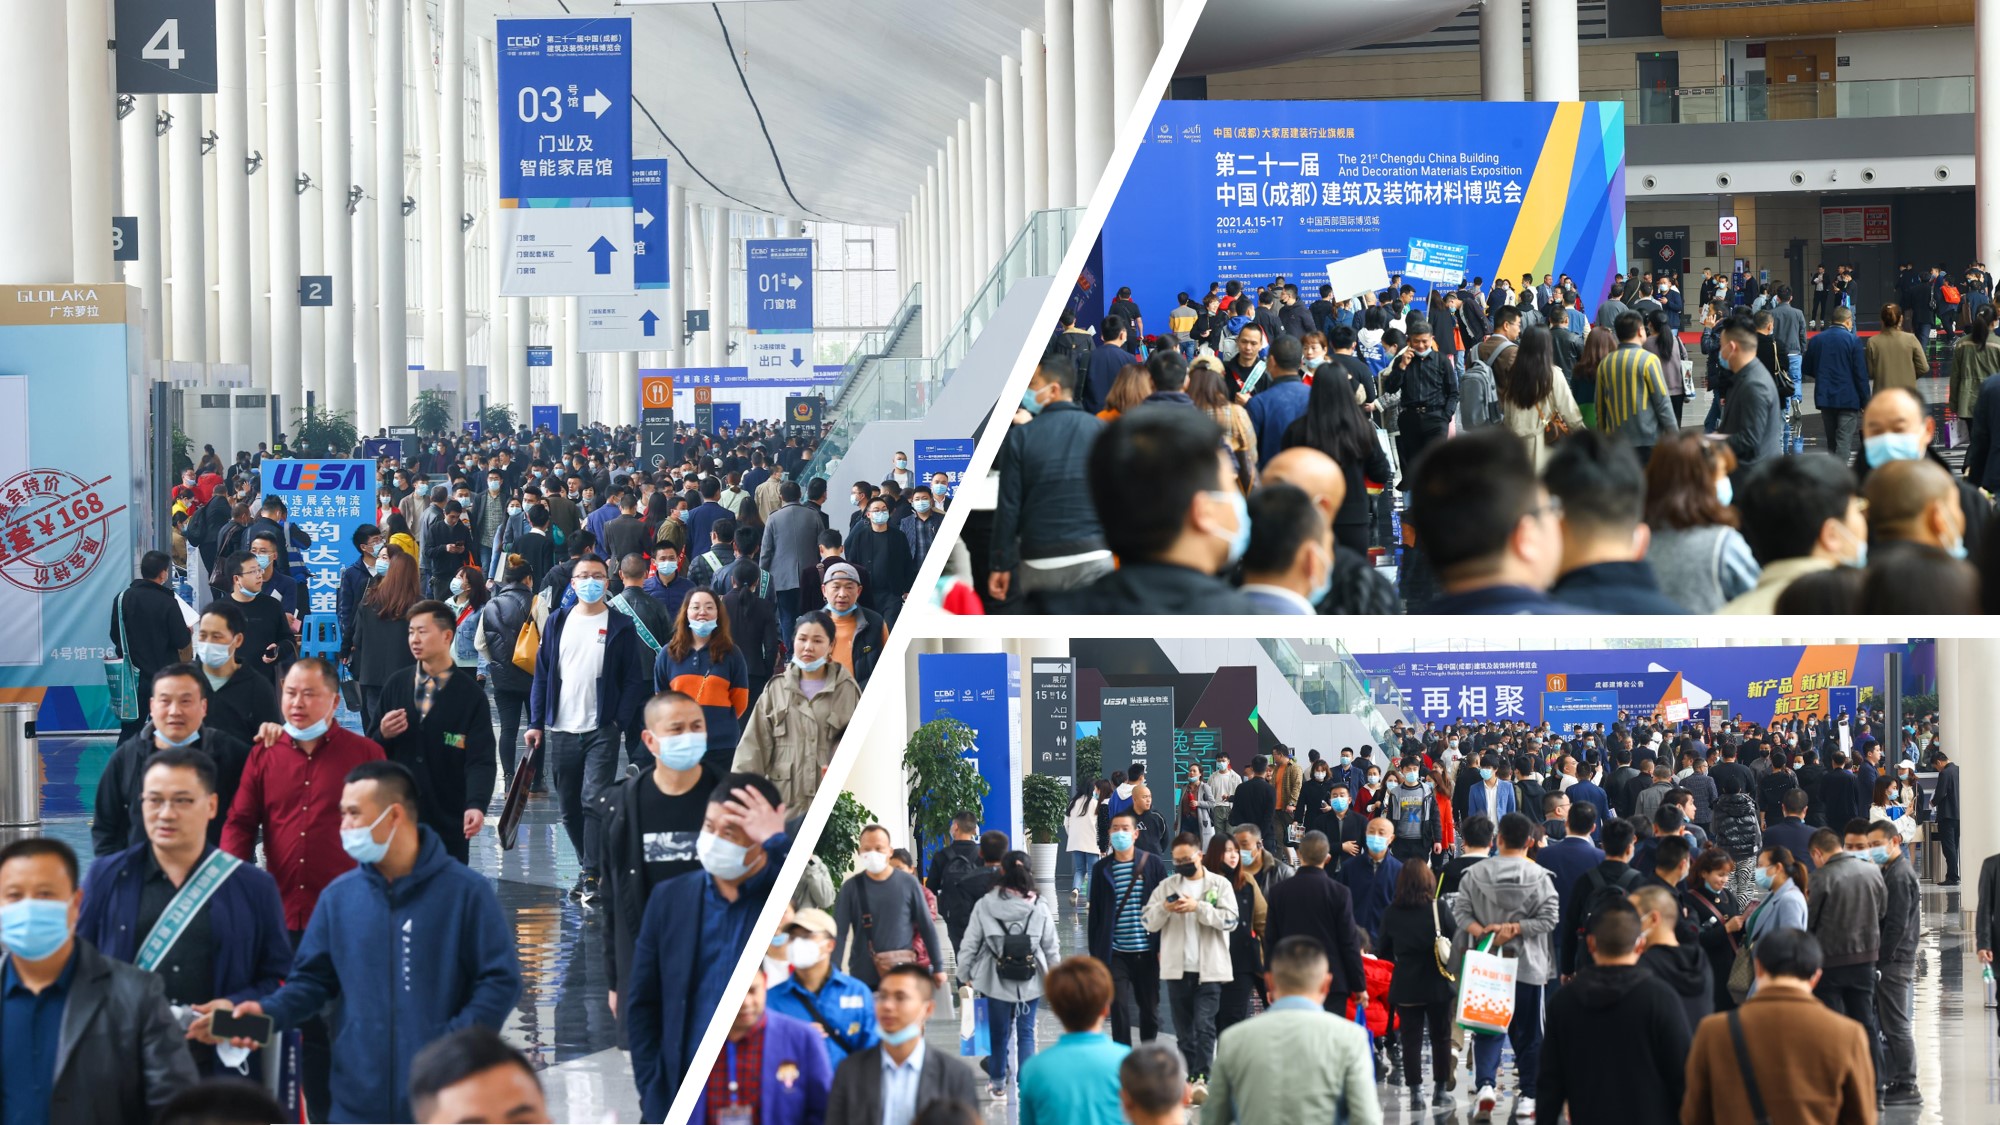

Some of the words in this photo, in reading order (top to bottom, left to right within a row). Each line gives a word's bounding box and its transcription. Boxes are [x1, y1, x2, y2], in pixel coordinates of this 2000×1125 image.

[142, 19, 185, 69] 4
[507, 36, 540, 47] CCBD
[518, 86, 562, 122] 03
[567, 84, 579, 108] 号馆
[538, 135, 594, 153] 门业及
[1215, 152, 1320, 177] 第二十一届
[1338, 154, 1357, 164] The
[1360, 154, 1378, 164] 21st
[1380, 153, 1425, 166] Chengdu
[1428, 153, 1457, 163] China
[1461, 152, 1499, 165] Building
[520, 158, 613, 177] 智能家居馆
[1338, 166, 1359, 176] And
[1362, 166, 1418, 176] Decoration
[1421, 166, 1468, 176] Materials
[1471, 165, 1522, 177] Exposition
[1217, 181, 1522, 207] 中国（成都）建筑及装饰材料博览会
[1217, 217, 1283, 227] 2021.4.15-17
[516, 234, 536, 242] 门窗馆
[759, 273, 779, 292] 01
[17, 289, 98, 303] GLOLAKA
[309, 283, 322, 300] 2
[50, 305, 99, 318] 广东萝拉
[764, 299, 797, 310] 门窗馆
[694, 315, 700, 327] 1
[760, 355, 781, 367] 出口
[273, 464, 365, 490] UESA
[286, 506, 360, 517] 定快递合作商
[51, 647, 114, 661] 4号馆T36
[1595, 680, 1644, 689] 成都建博会公告
[1747, 677, 1793, 698] 新产品
[1801, 669, 1847, 692] 新材料
[1035, 691, 1047, 699] 15
[1056, 691, 1067, 700] 16
[1775, 693, 1820, 715] 新工艺
[1060, 721, 1067, 730] D
